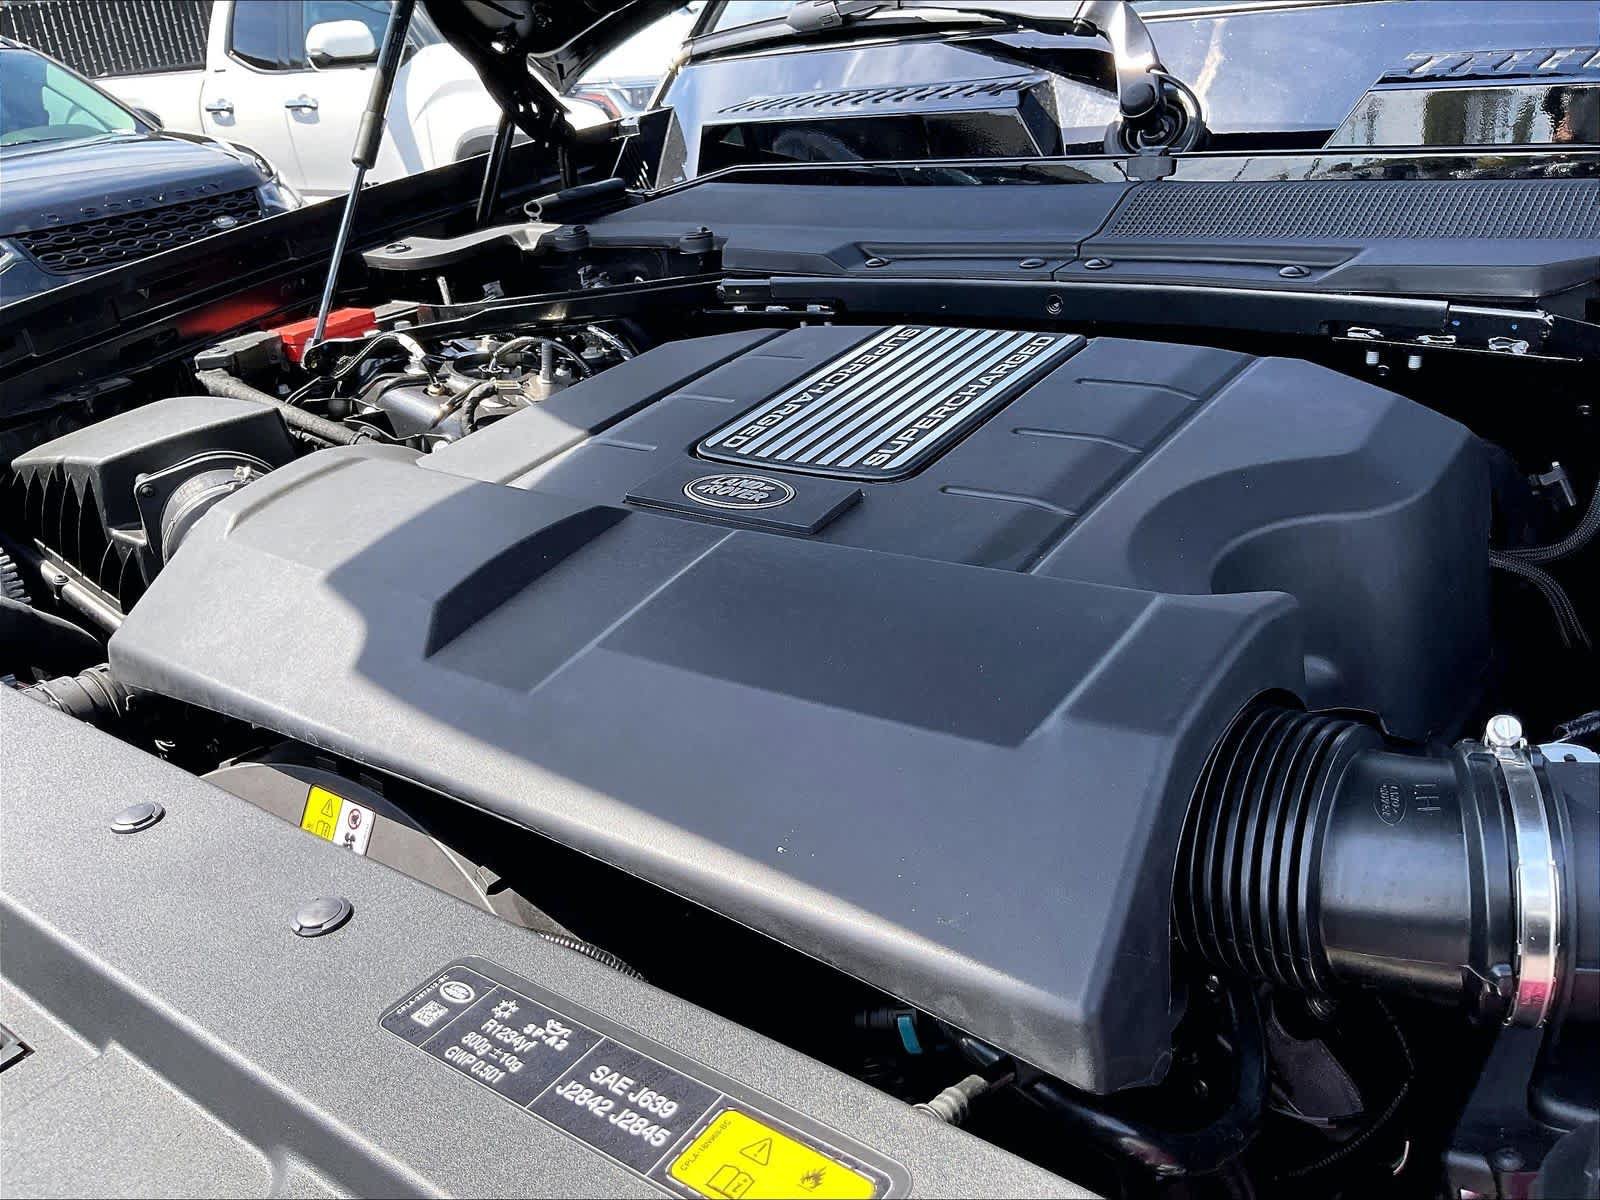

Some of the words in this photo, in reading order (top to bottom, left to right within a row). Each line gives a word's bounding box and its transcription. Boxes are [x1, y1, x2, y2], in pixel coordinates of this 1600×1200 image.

[722, 328, 920, 448] SUPERCHARGED
[863, 336, 1056, 466] SUPERCHARGED
[699, 485, 769, 502] ROVER
[711, 477, 766, 489] LAND
[461, 1031, 492, 1057] 800g
[481, 1018, 540, 1052] R1234yf
[444, 1045, 478, 1067] GWP
[470, 1060, 507, 1084] 0.501
[589, 1065, 635, 1097] SAE
[628, 1087, 679, 1119] J639
[555, 1080, 616, 1118] J2842
[609, 1108, 672, 1147] J2845
